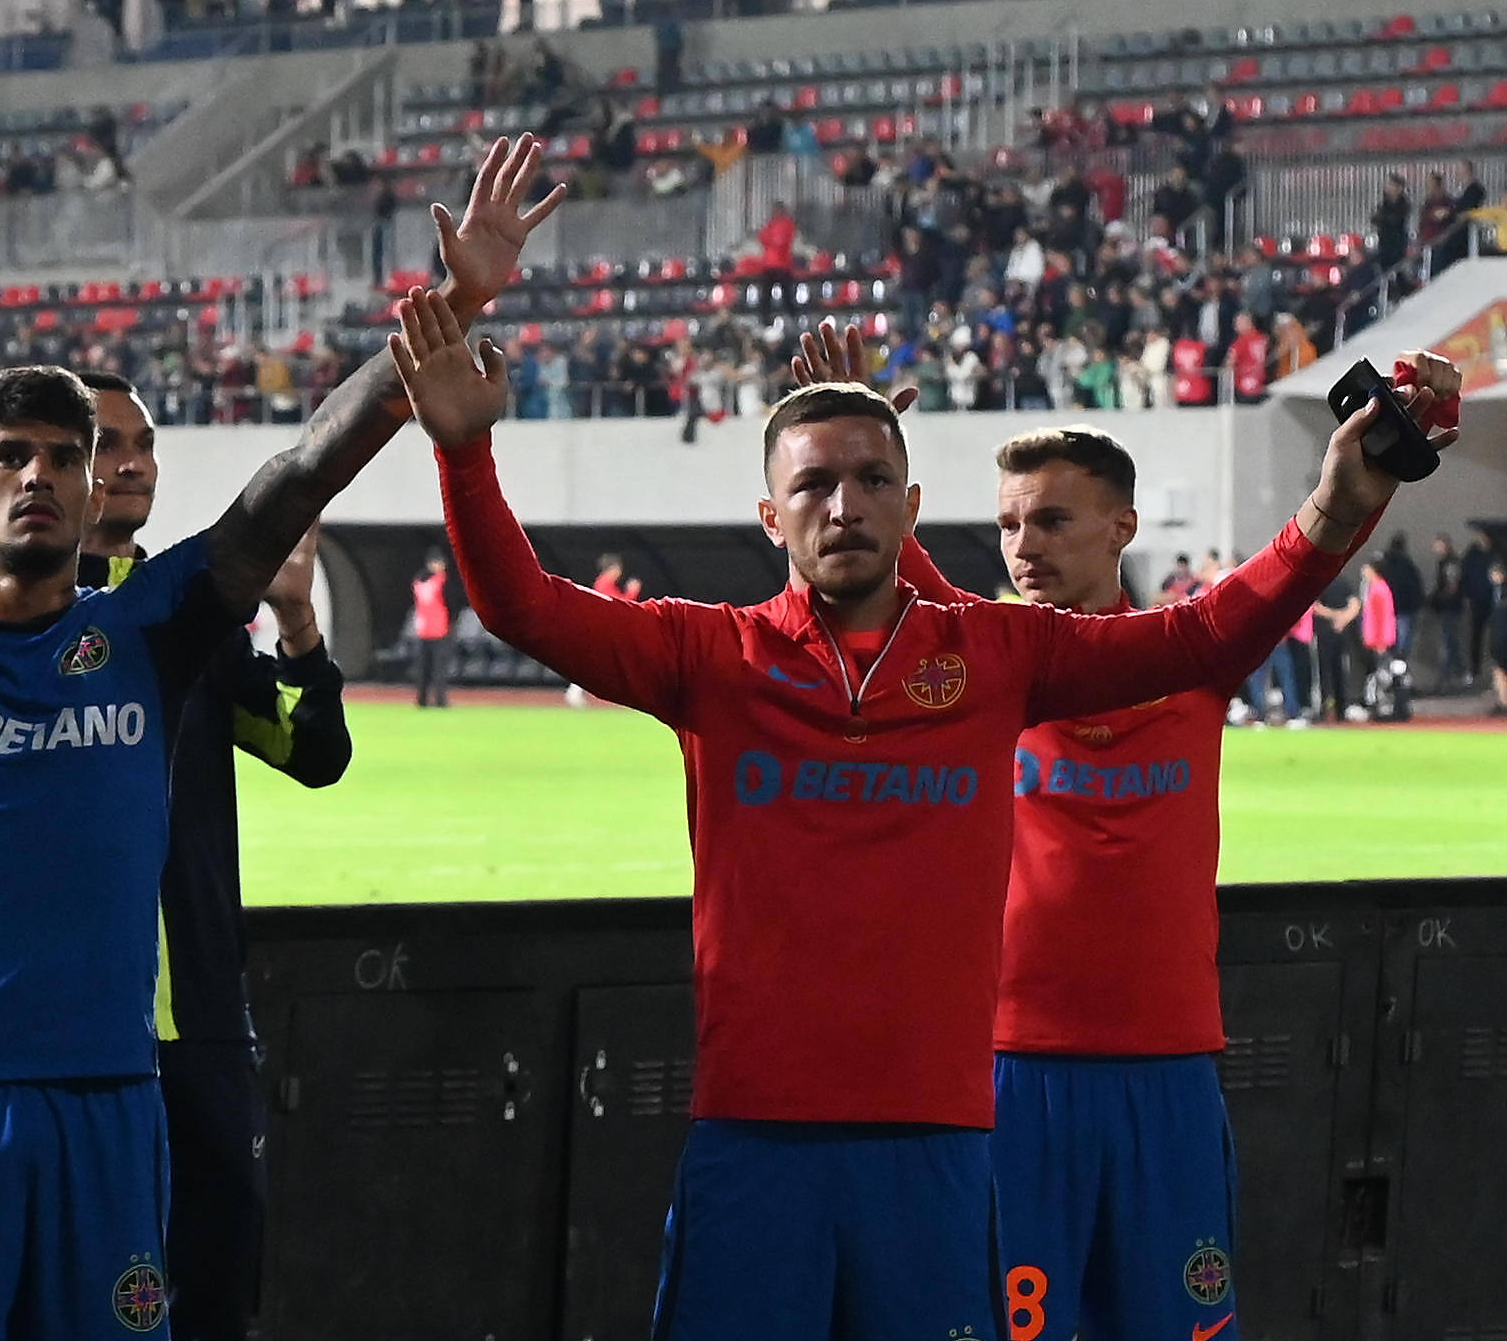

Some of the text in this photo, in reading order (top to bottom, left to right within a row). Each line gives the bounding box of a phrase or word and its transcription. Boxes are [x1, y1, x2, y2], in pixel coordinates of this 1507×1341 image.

[792, 760, 978, 807] BETANO
[1048, 758, 1191, 799] BETANO
[1285, 923, 1335, 952] OK
[1418, 917, 1457, 948] OK
